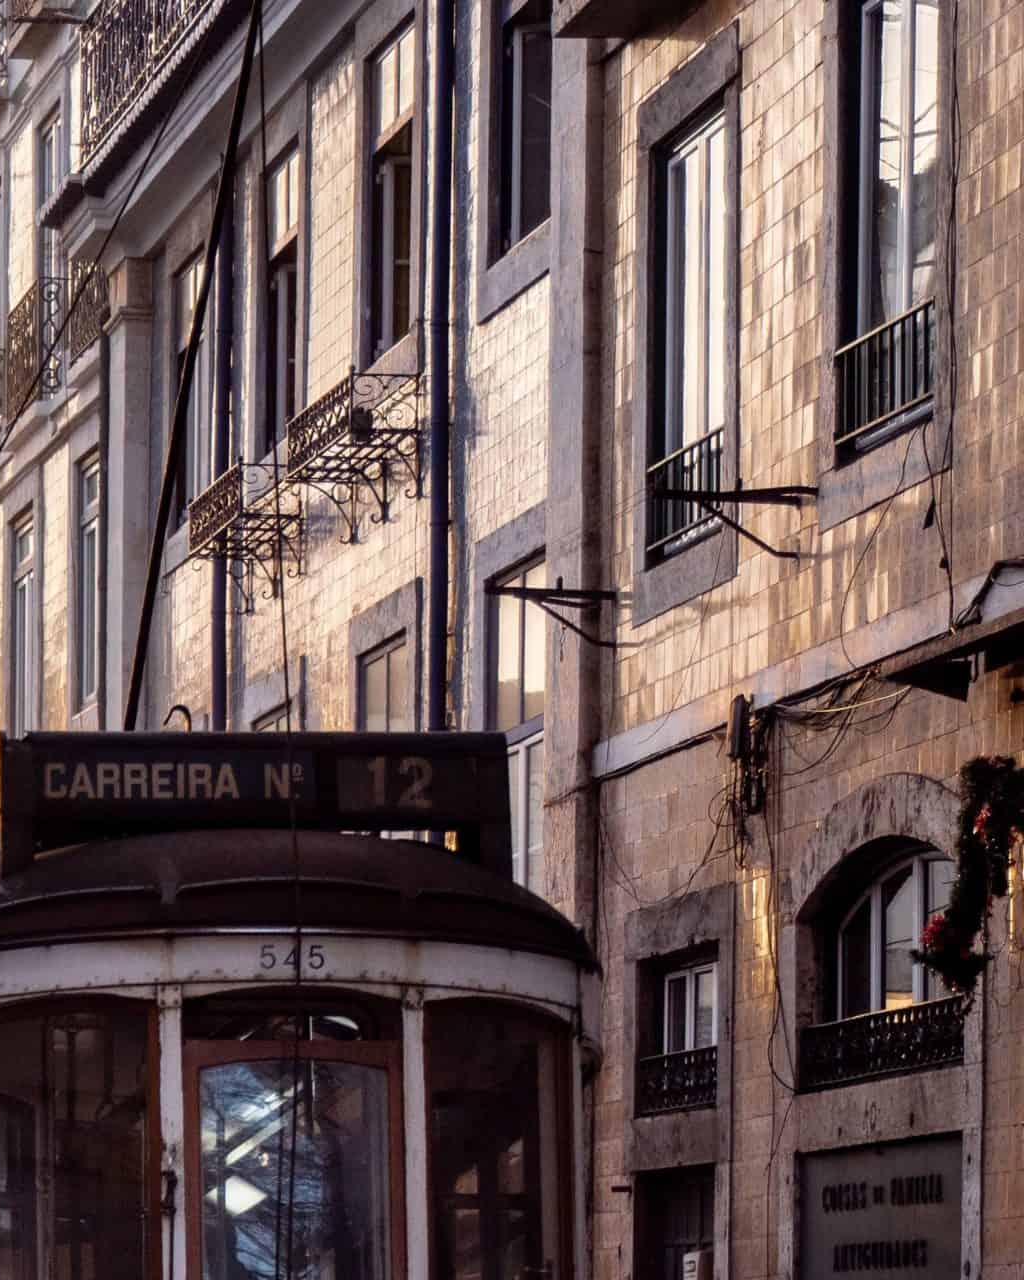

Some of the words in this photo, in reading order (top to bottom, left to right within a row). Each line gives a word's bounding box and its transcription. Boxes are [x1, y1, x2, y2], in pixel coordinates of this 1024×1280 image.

[43, 762, 241, 800] CARREIRA
[367, 757, 433, 808] 12
[259, 944, 325, 970] 545
